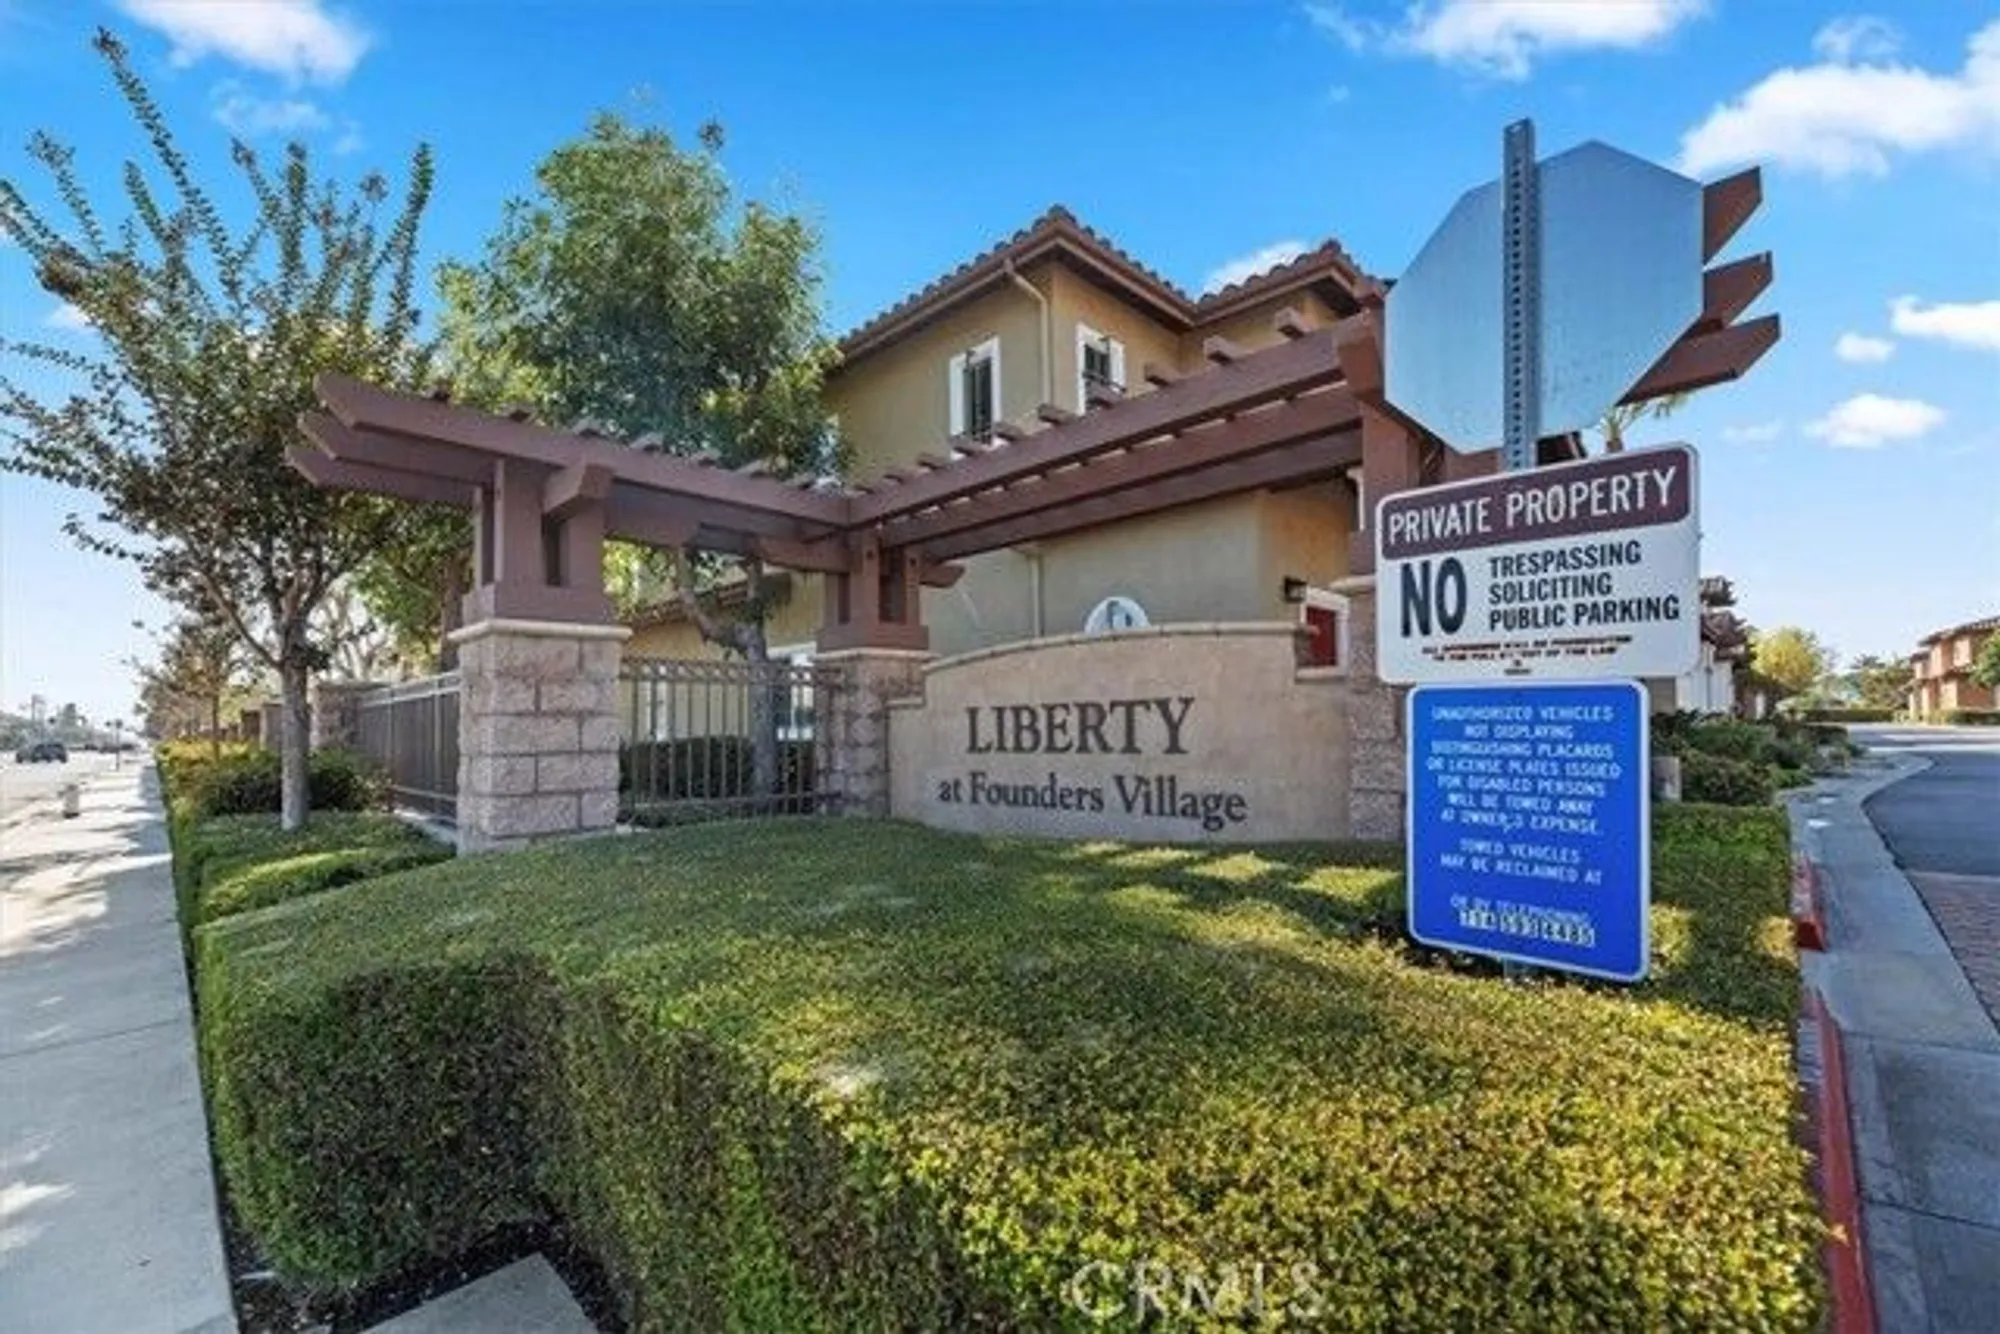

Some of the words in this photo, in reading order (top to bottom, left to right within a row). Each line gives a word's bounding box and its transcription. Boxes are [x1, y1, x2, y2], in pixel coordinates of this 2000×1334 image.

[1389, 497, 1492, 544] PRIVATE
[1506, 466, 1676, 527] PROPERTY
[1489, 540, 1641, 578] TRESPASSING
[1402, 557, 1467, 637] NO
[1489, 573, 1612, 604] SOLICITING
[1489, 605, 1566, 631] PUBLIC
[1574, 595, 1679, 626] PARKING
[966, 697, 1195, 754] LIBERTY
[1540, 706, 1614, 721] VEHICLES
[1494, 725, 1574, 739] DISPLAYING
[1537, 742, 1614, 760] PLACARDS
[1449, 759, 1502, 773] LICENSE
[1508, 761, 1559, 776] PLATES
[1565, 763, 1623, 780] ISSUED
[1468, 776, 1533, 792] DISABLED
[1537, 780, 1606, 797] PERSONS
[939, 780, 962, 802] at
[969, 772, 1104, 812] Founders
[1114, 775, 1247, 832] Village
[1509, 843, 1580, 864] VEHICLES
[1496, 859, 1579, 883] RECLAIMED
